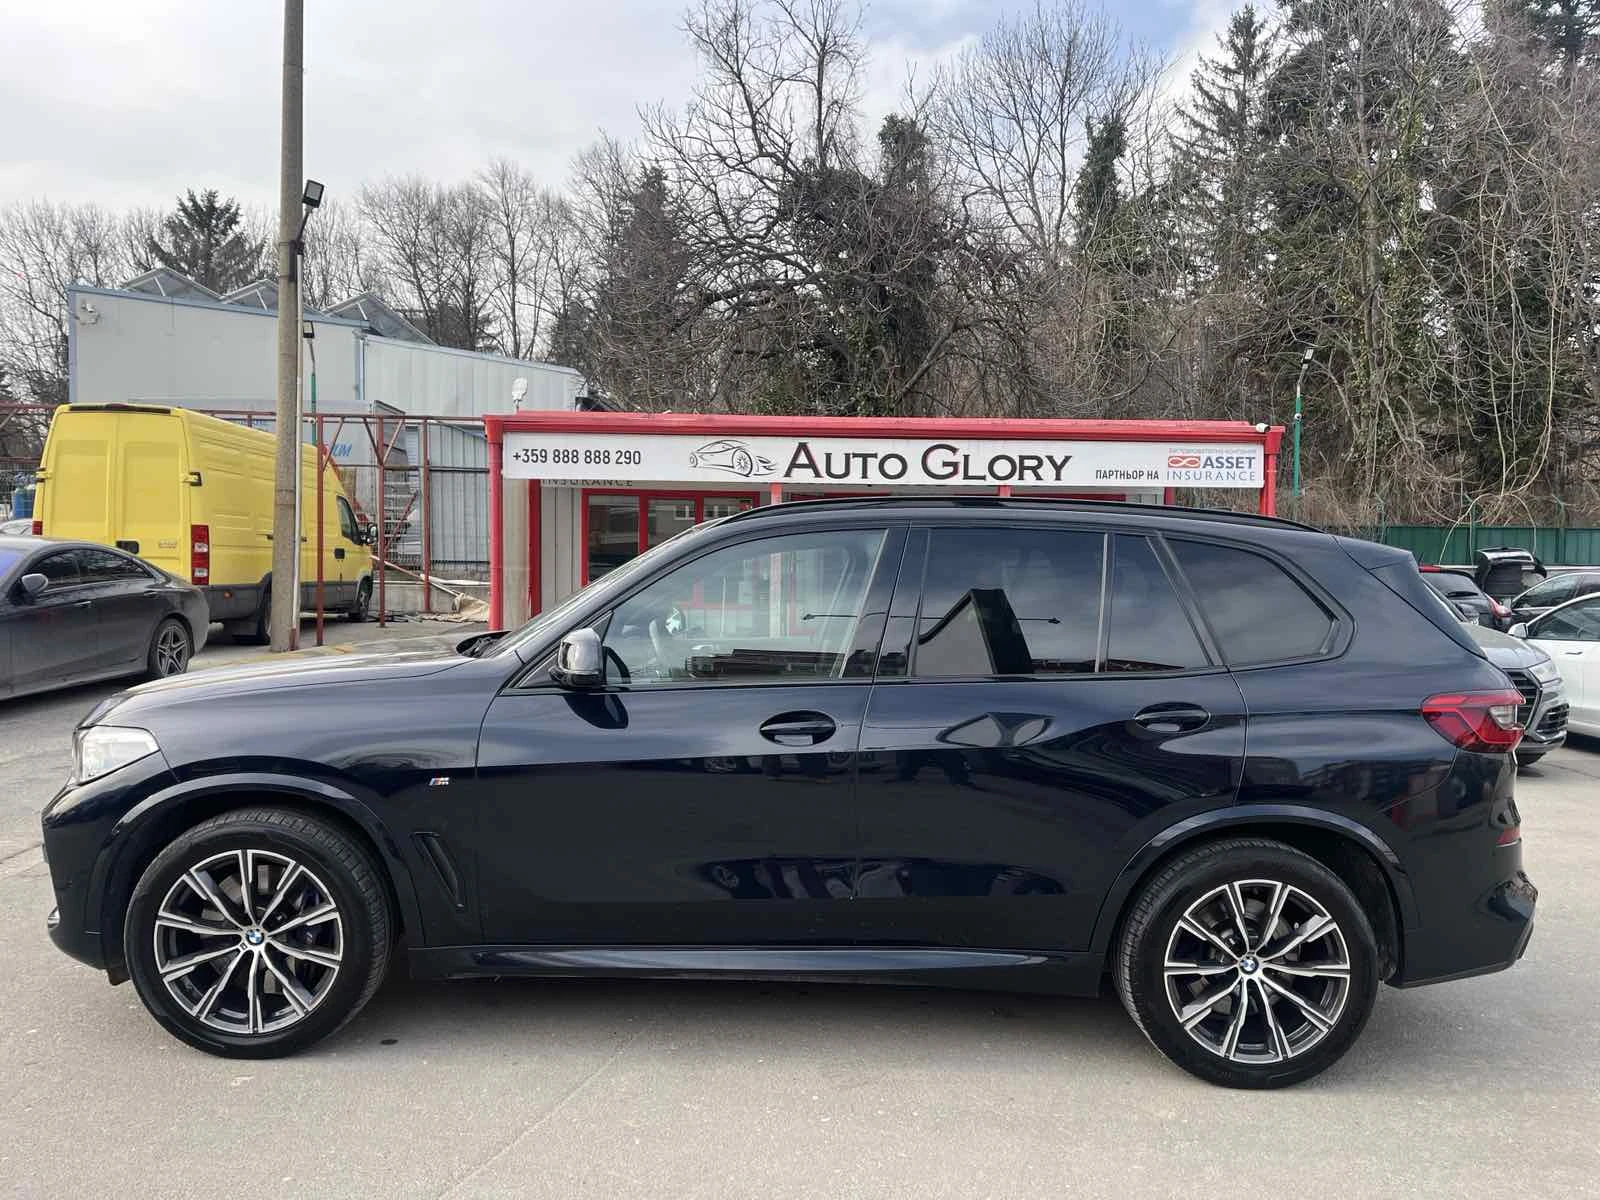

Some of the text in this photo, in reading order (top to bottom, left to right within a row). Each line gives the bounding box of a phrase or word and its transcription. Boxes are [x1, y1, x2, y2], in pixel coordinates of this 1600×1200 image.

[513, 448, 642, 465] +359 888 888 290
[783, 441, 1073, 482] AUTO GLORY
[1202, 456, 1256, 469] ASSET
[1147, 470, 1160, 480] НА
[1166, 471, 1256, 481] INSURANCE
